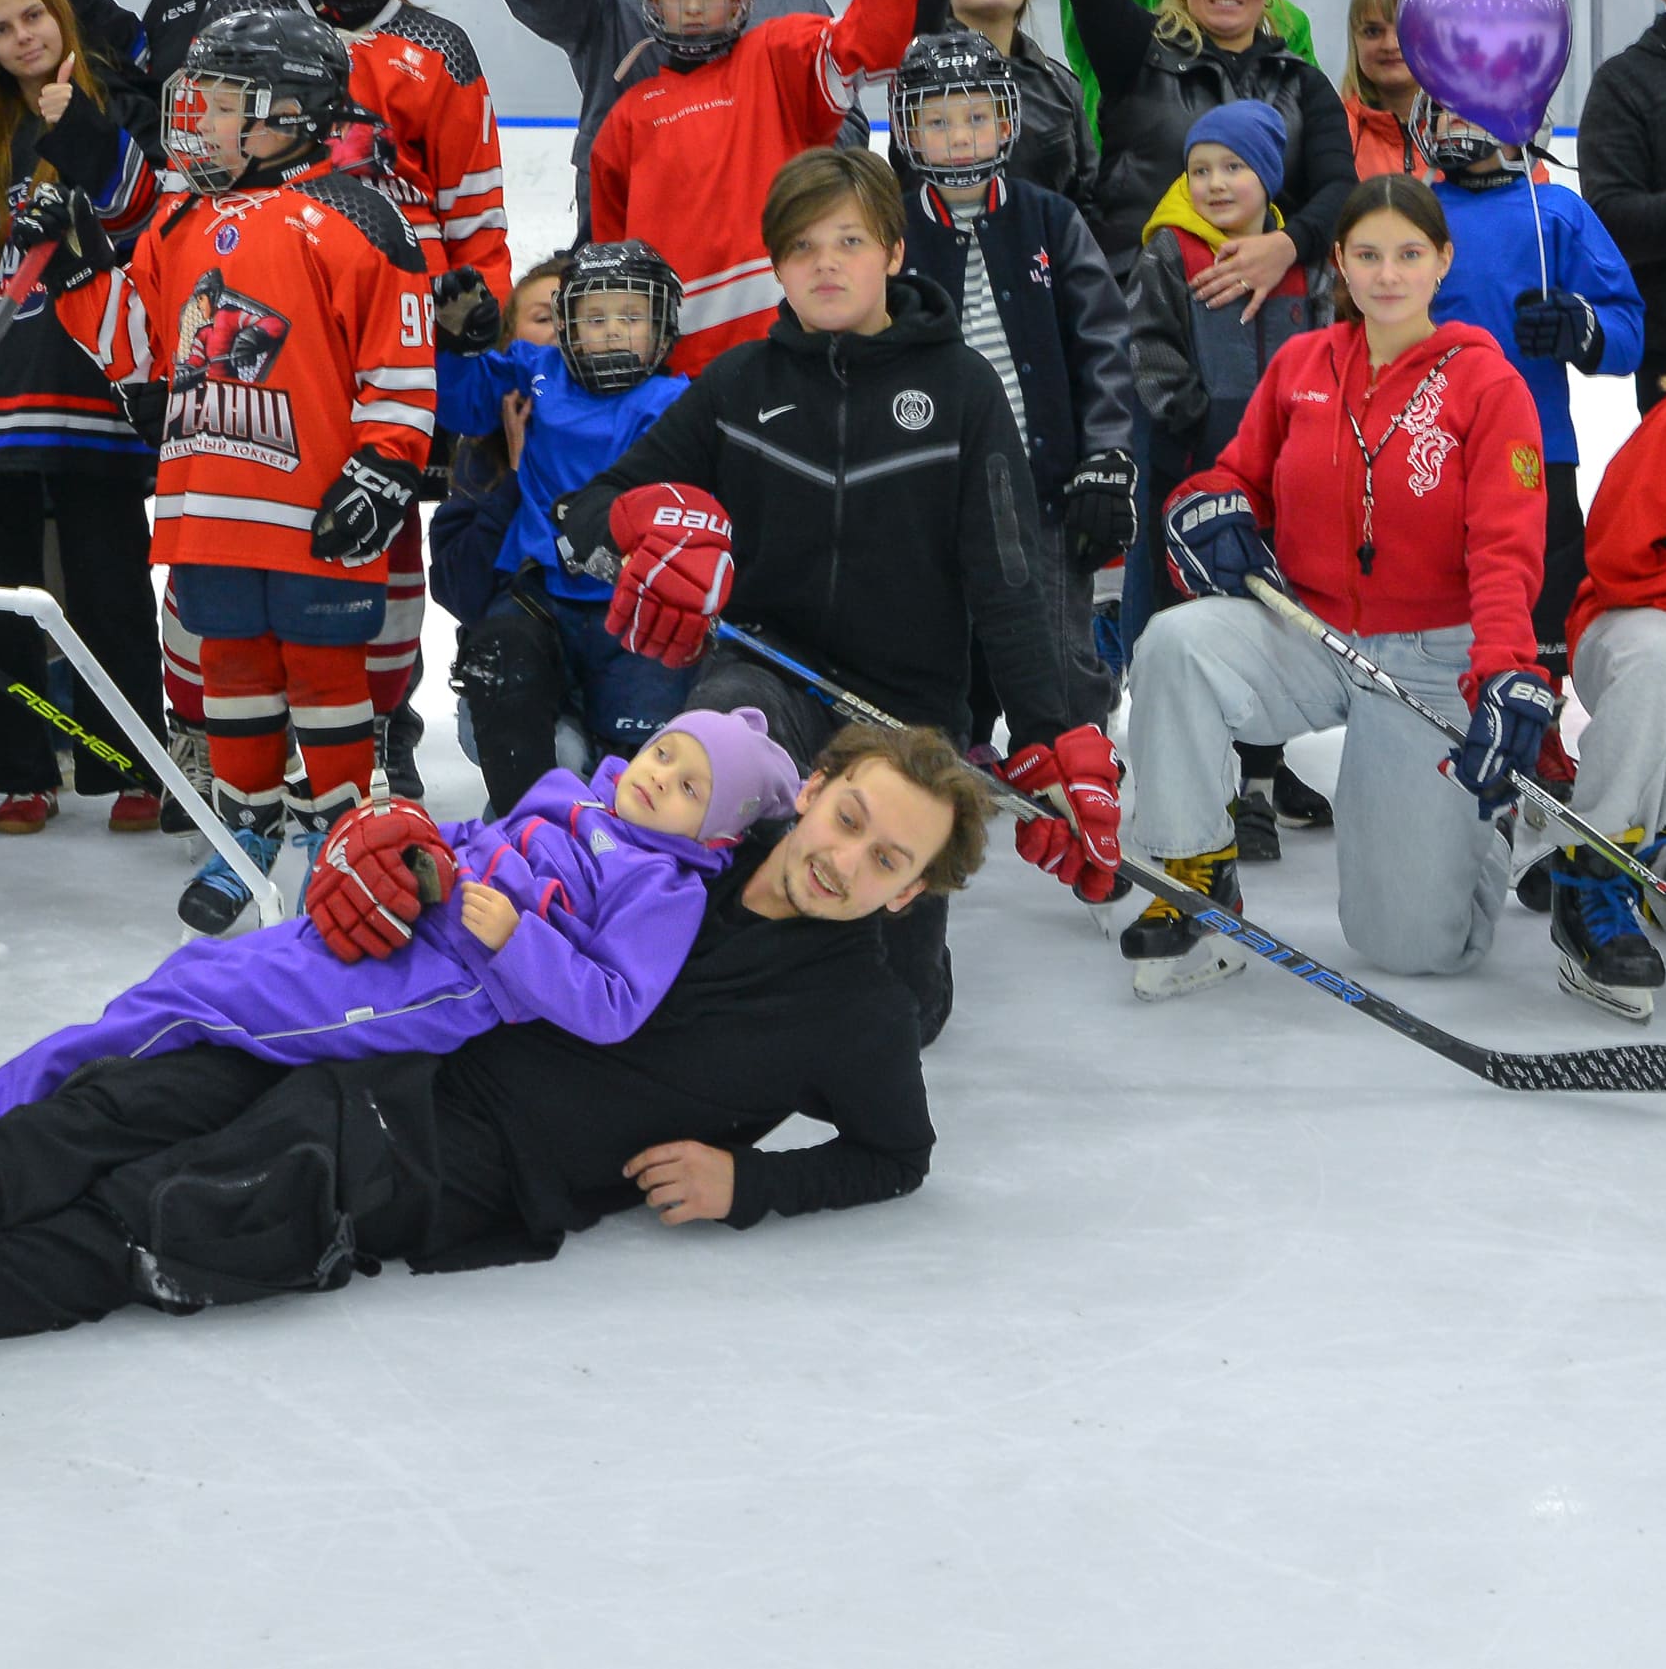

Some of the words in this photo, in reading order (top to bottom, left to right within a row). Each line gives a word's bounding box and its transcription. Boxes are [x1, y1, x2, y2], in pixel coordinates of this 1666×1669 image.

[162, 380, 296, 454] РЕАНШ
[1182, 494, 1254, 533] BAUE
[7, 682, 133, 772] FISCHER
[1194, 909, 1367, 1005] BAUER
